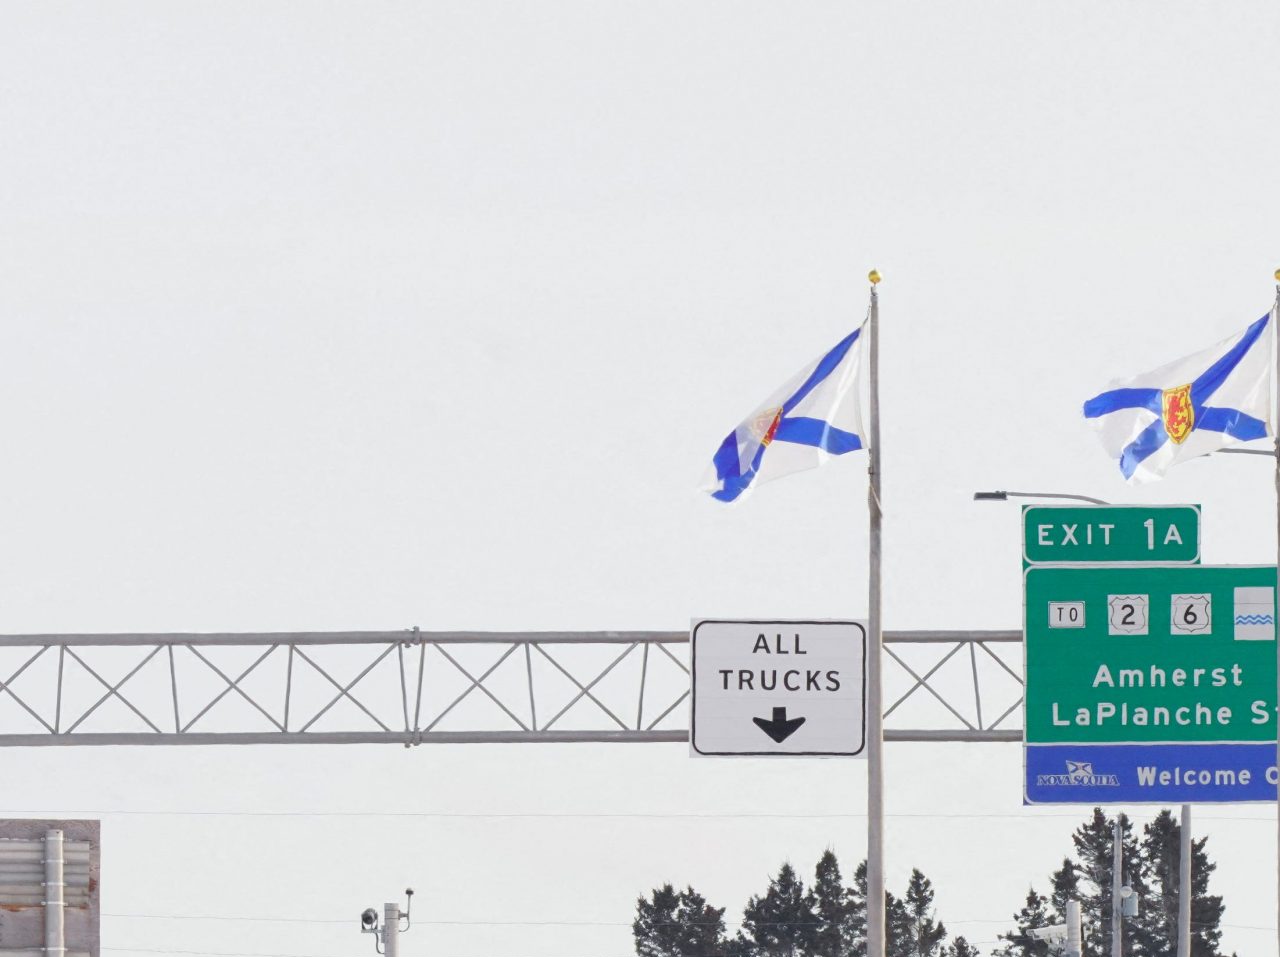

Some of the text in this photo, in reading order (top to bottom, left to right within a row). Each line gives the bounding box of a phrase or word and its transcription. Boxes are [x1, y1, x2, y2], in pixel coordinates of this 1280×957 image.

[1037, 518, 1183, 550] EXIT 1A
[1057, 607, 1079, 623] TO
[1121, 604, 1136, 626] 2
[1183, 603, 1198, 626] 6
[752, 633, 807, 655] ALL
[719, 669, 841, 692] TRUCKS
[1092, 663, 1243, 688] Amherst
[1051, 700, 1279, 727] LaPlanche S
[1137, 766, 1250, 786] Welcome
